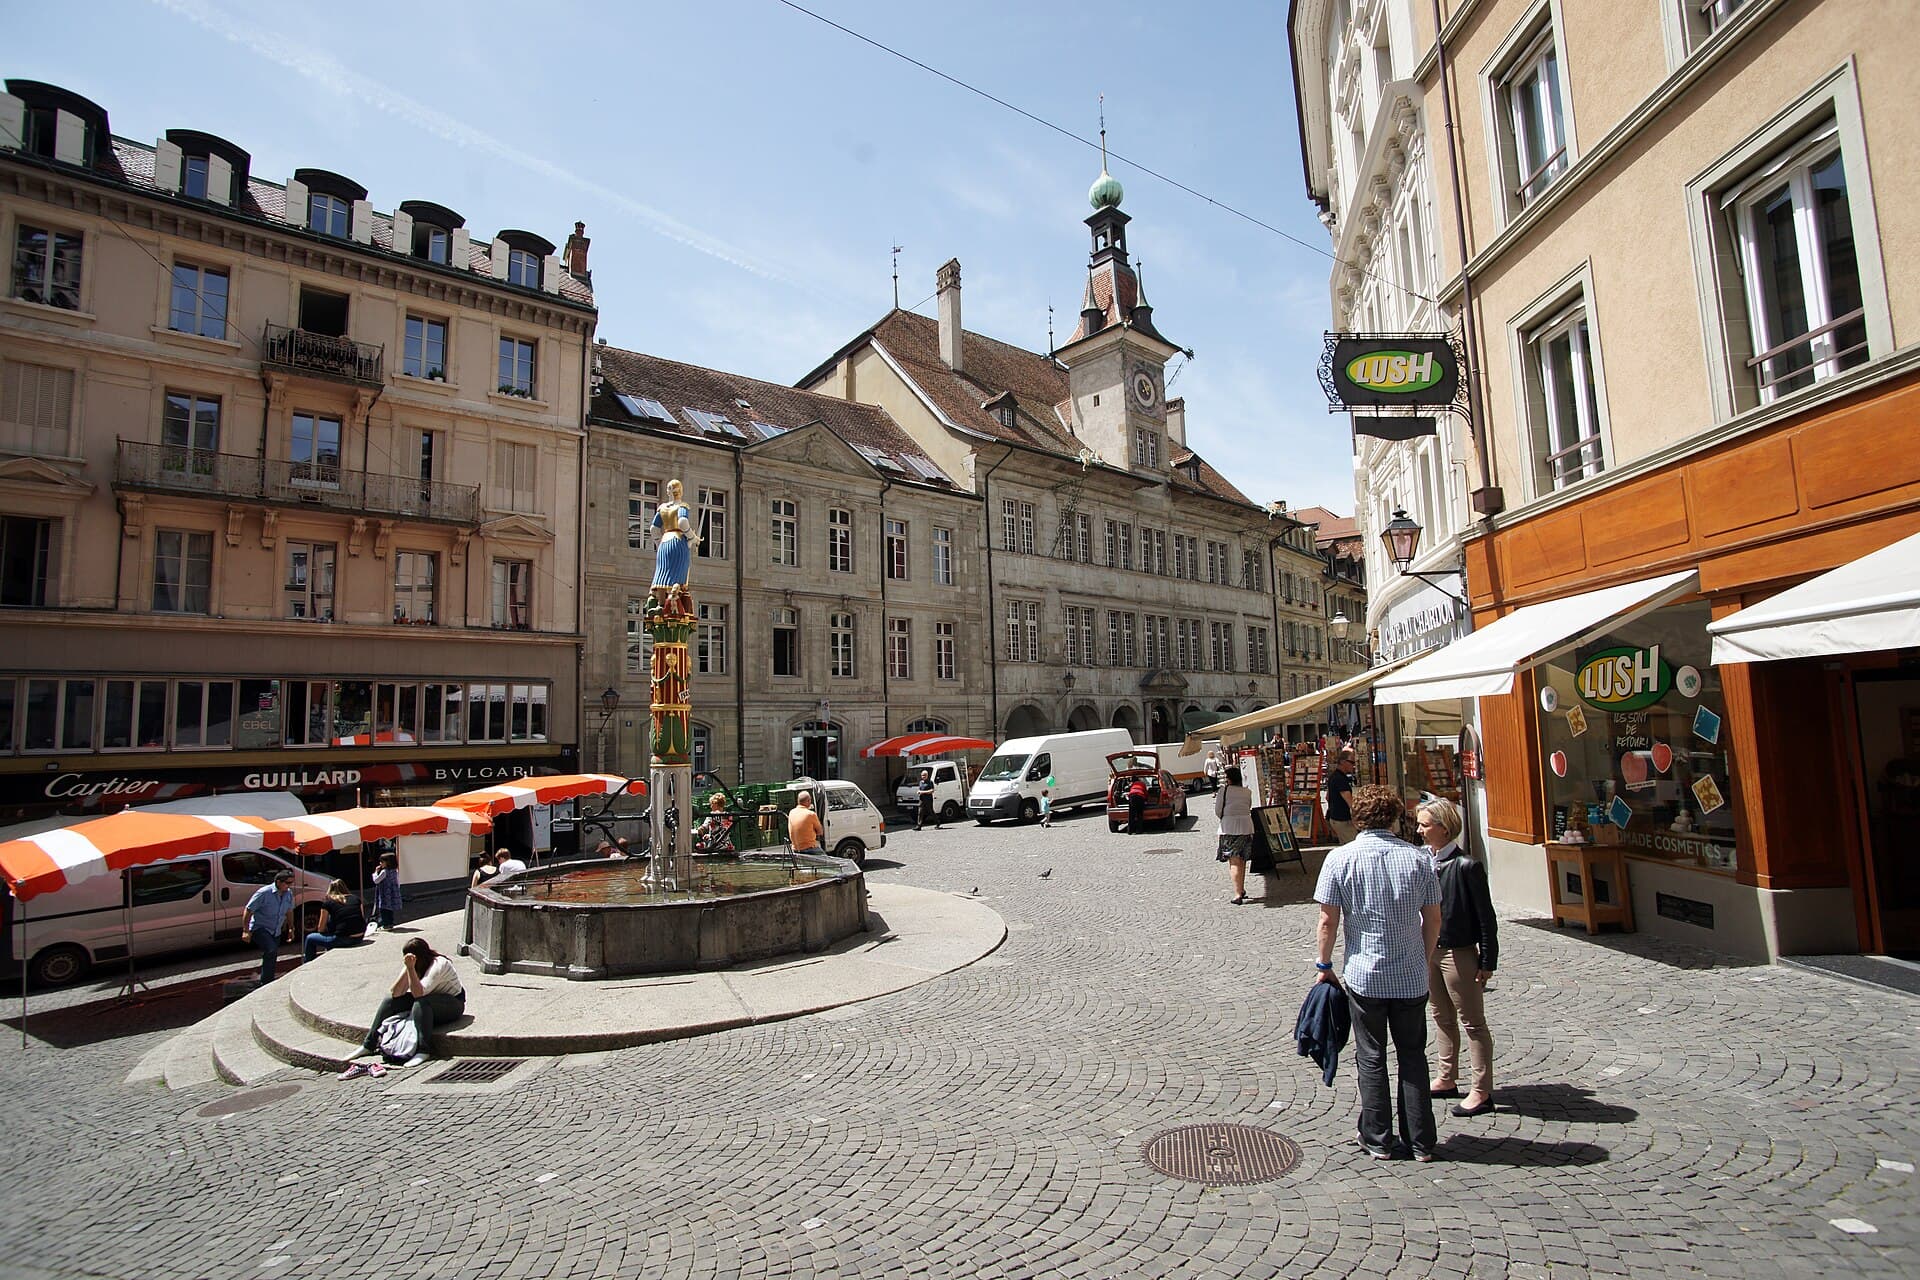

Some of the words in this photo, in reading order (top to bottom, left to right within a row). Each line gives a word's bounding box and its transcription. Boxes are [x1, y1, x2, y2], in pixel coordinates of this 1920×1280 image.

[1356, 352, 1433, 383] LUSH
[1385, 623, 1402, 646] CAVE
[1402, 617, 1412, 640] DU
[1413, 598, 1455, 637] CHARDON
[1584, 644, 1660, 699] LUSH
[242, 719, 275, 730] EBEL
[1628, 711, 1649, 724] SONT
[1625, 723, 1638, 736] DE
[243, 769, 362, 789] GUILLARD
[435, 765, 534, 780] BVLGARI
[44, 773, 159, 798] Cartier
[1654, 835, 1722, 860] COSMETICS
